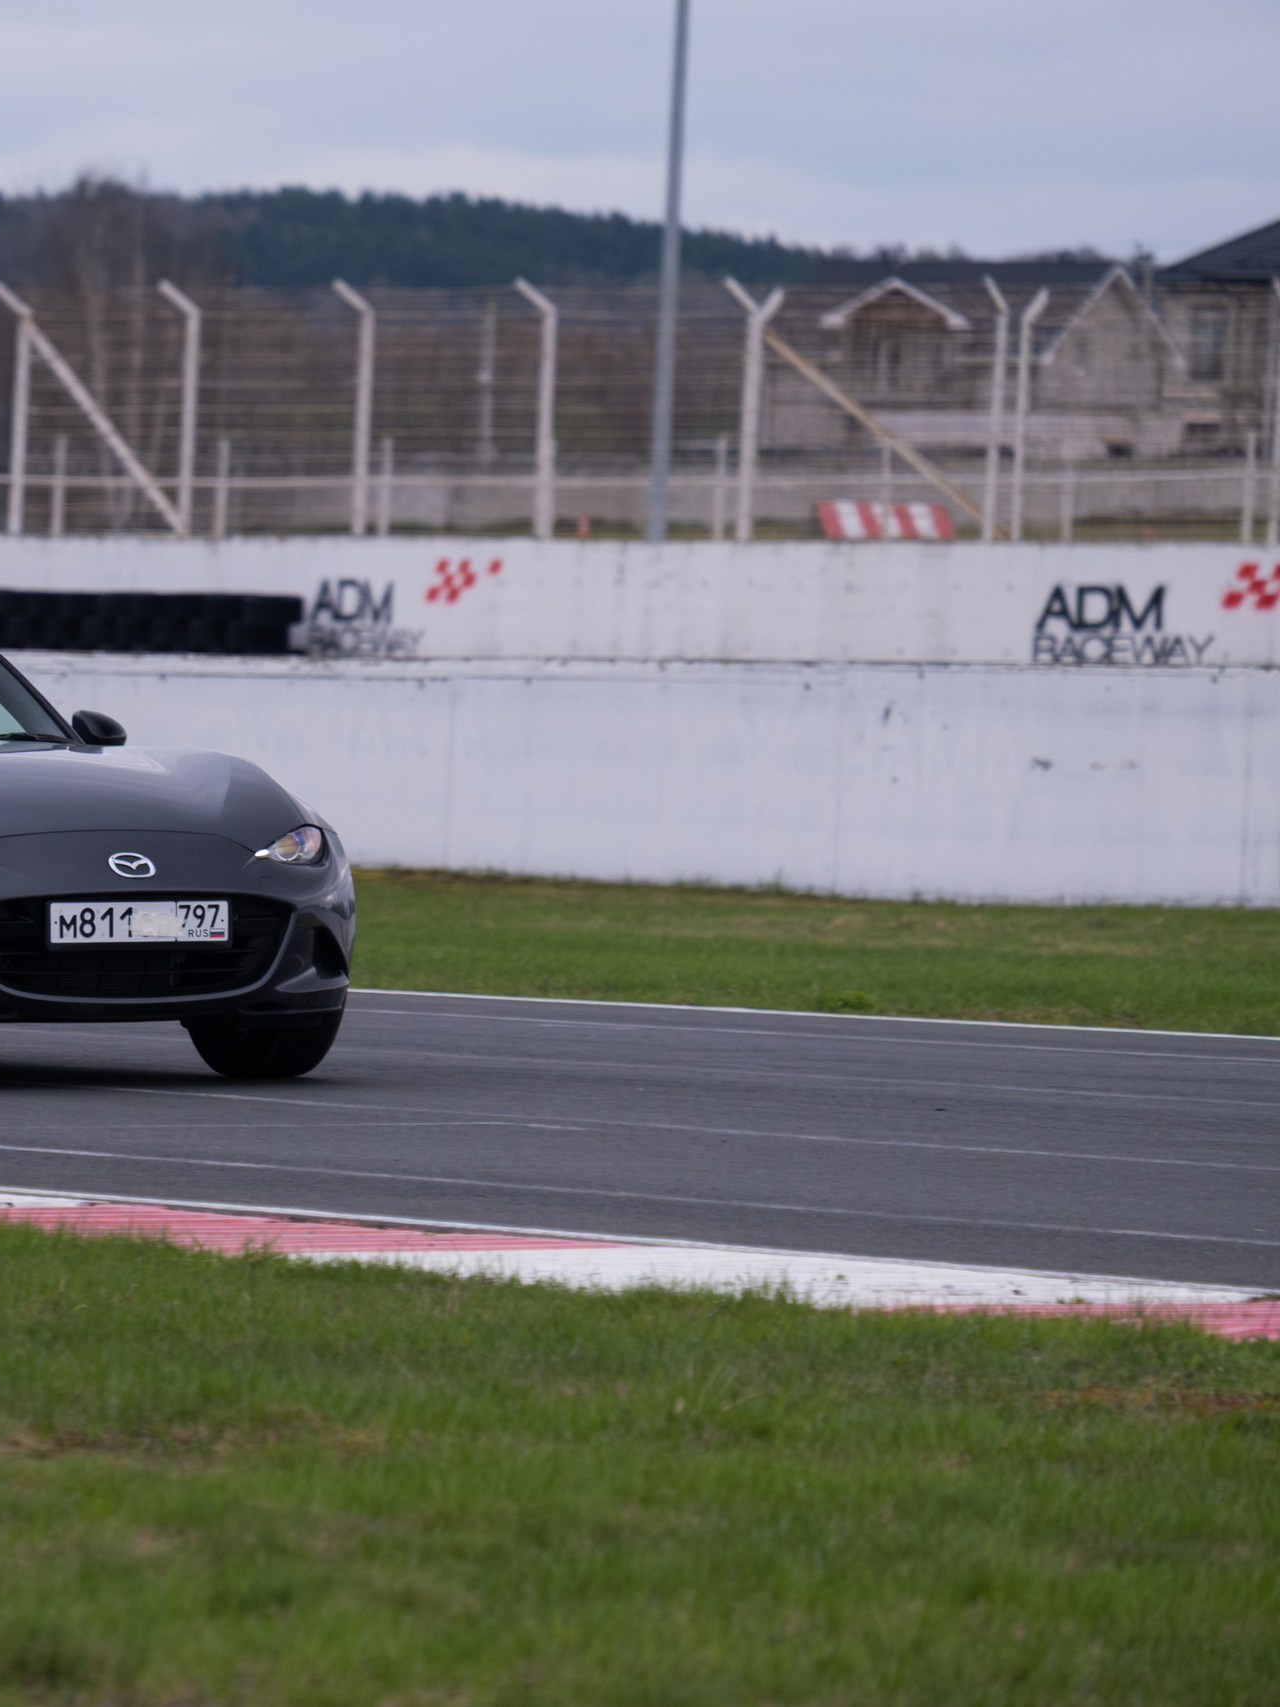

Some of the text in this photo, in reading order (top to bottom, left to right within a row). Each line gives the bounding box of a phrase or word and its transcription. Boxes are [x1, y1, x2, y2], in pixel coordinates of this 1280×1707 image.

[309, 578, 394, 625] ADM
[1035, 584, 1166, 631] ADM
[1032, 632, 1215, 665] RACEWAY
[178, 904, 220, 928] 797
[188, 928, 209, 938] RUS
